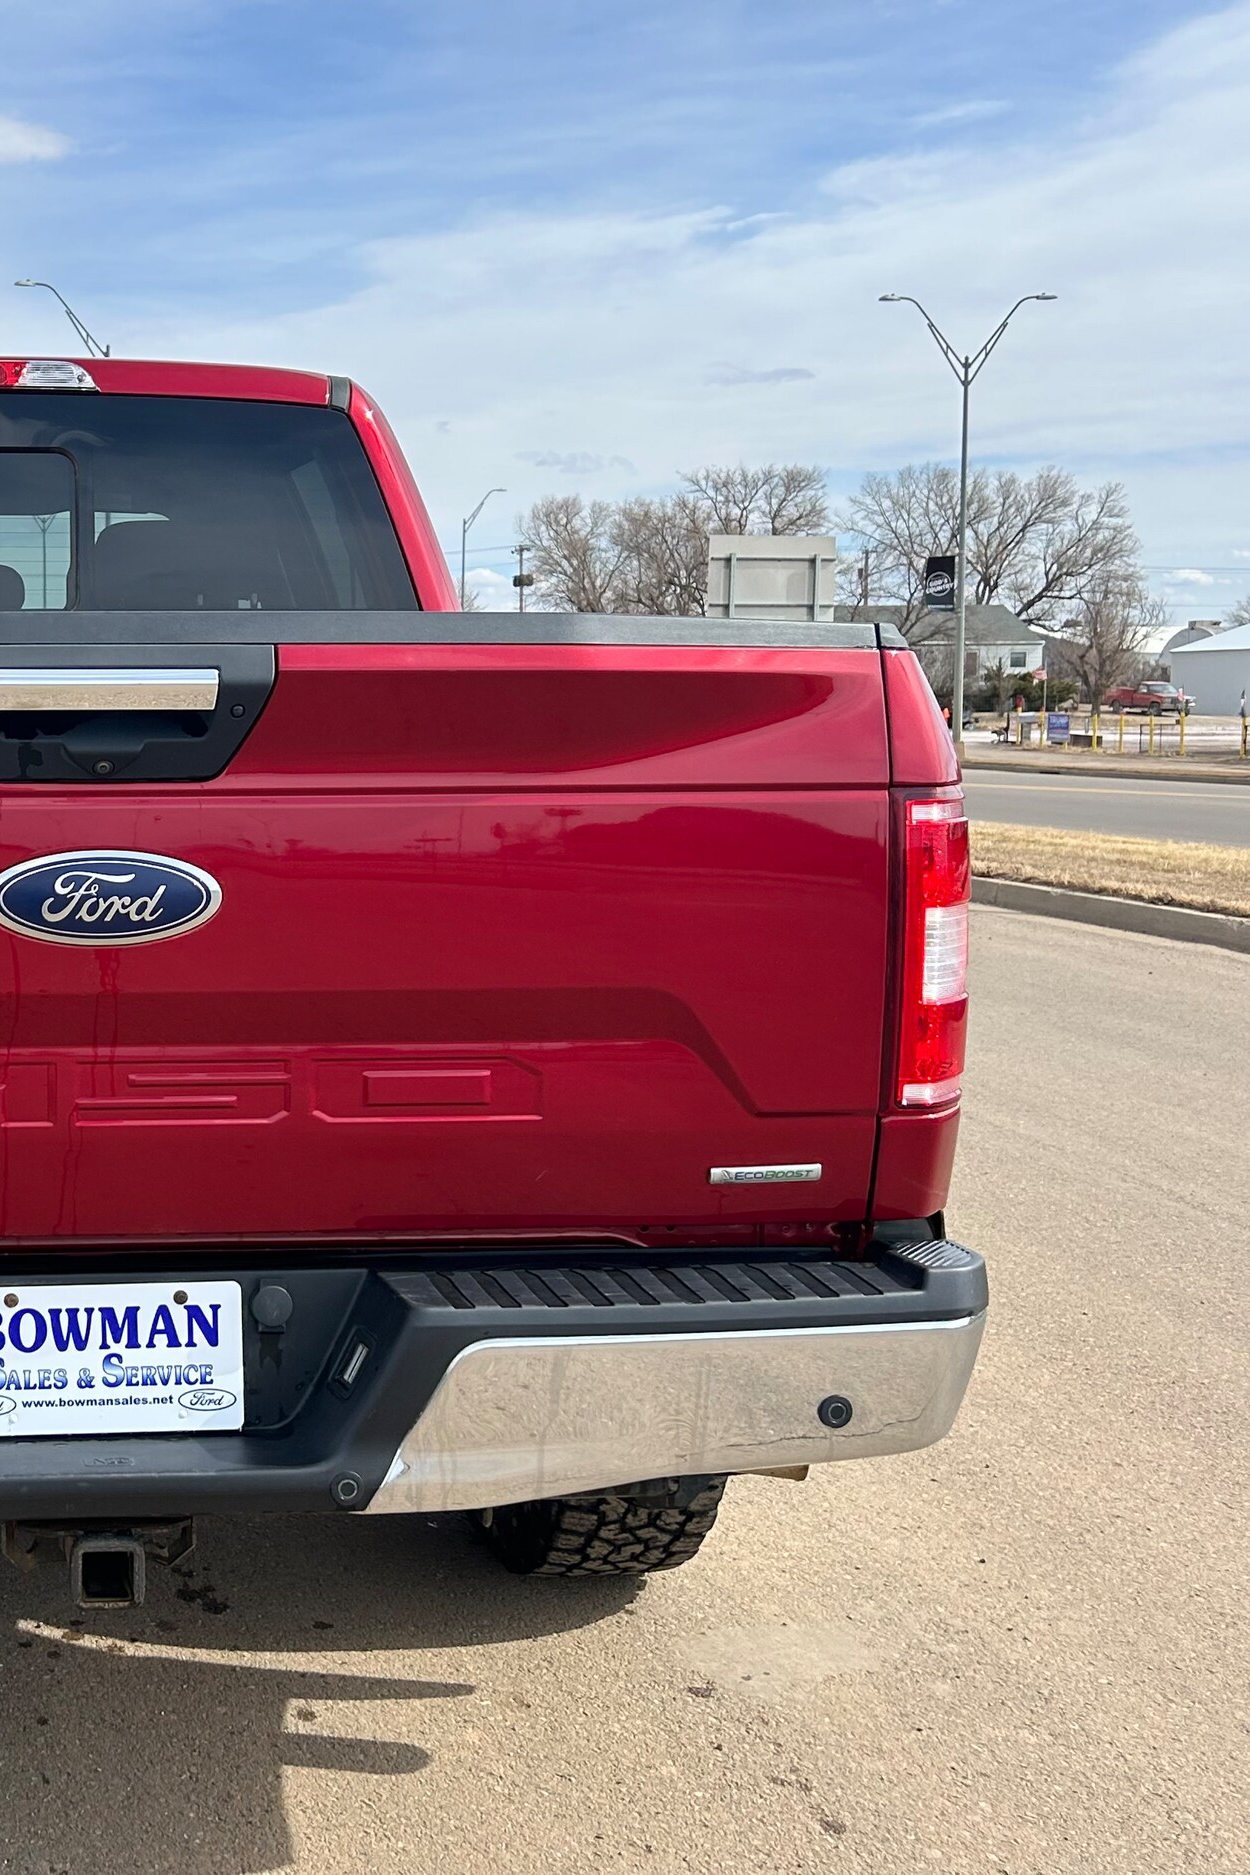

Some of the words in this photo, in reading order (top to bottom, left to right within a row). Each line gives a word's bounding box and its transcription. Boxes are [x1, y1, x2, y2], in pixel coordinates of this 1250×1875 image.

[925, 582, 954, 595] COUNTRY
[41, 870, 167, 923] Ford
[734, 1169, 814, 1181] ECOBOOST
[76, 1367, 96, 1389] &
[102, 1353, 214, 1388] SERVICE
[21, 1394, 174, 1409] www.bowmansales.net
[189, 1390, 225, 1407] Ford
